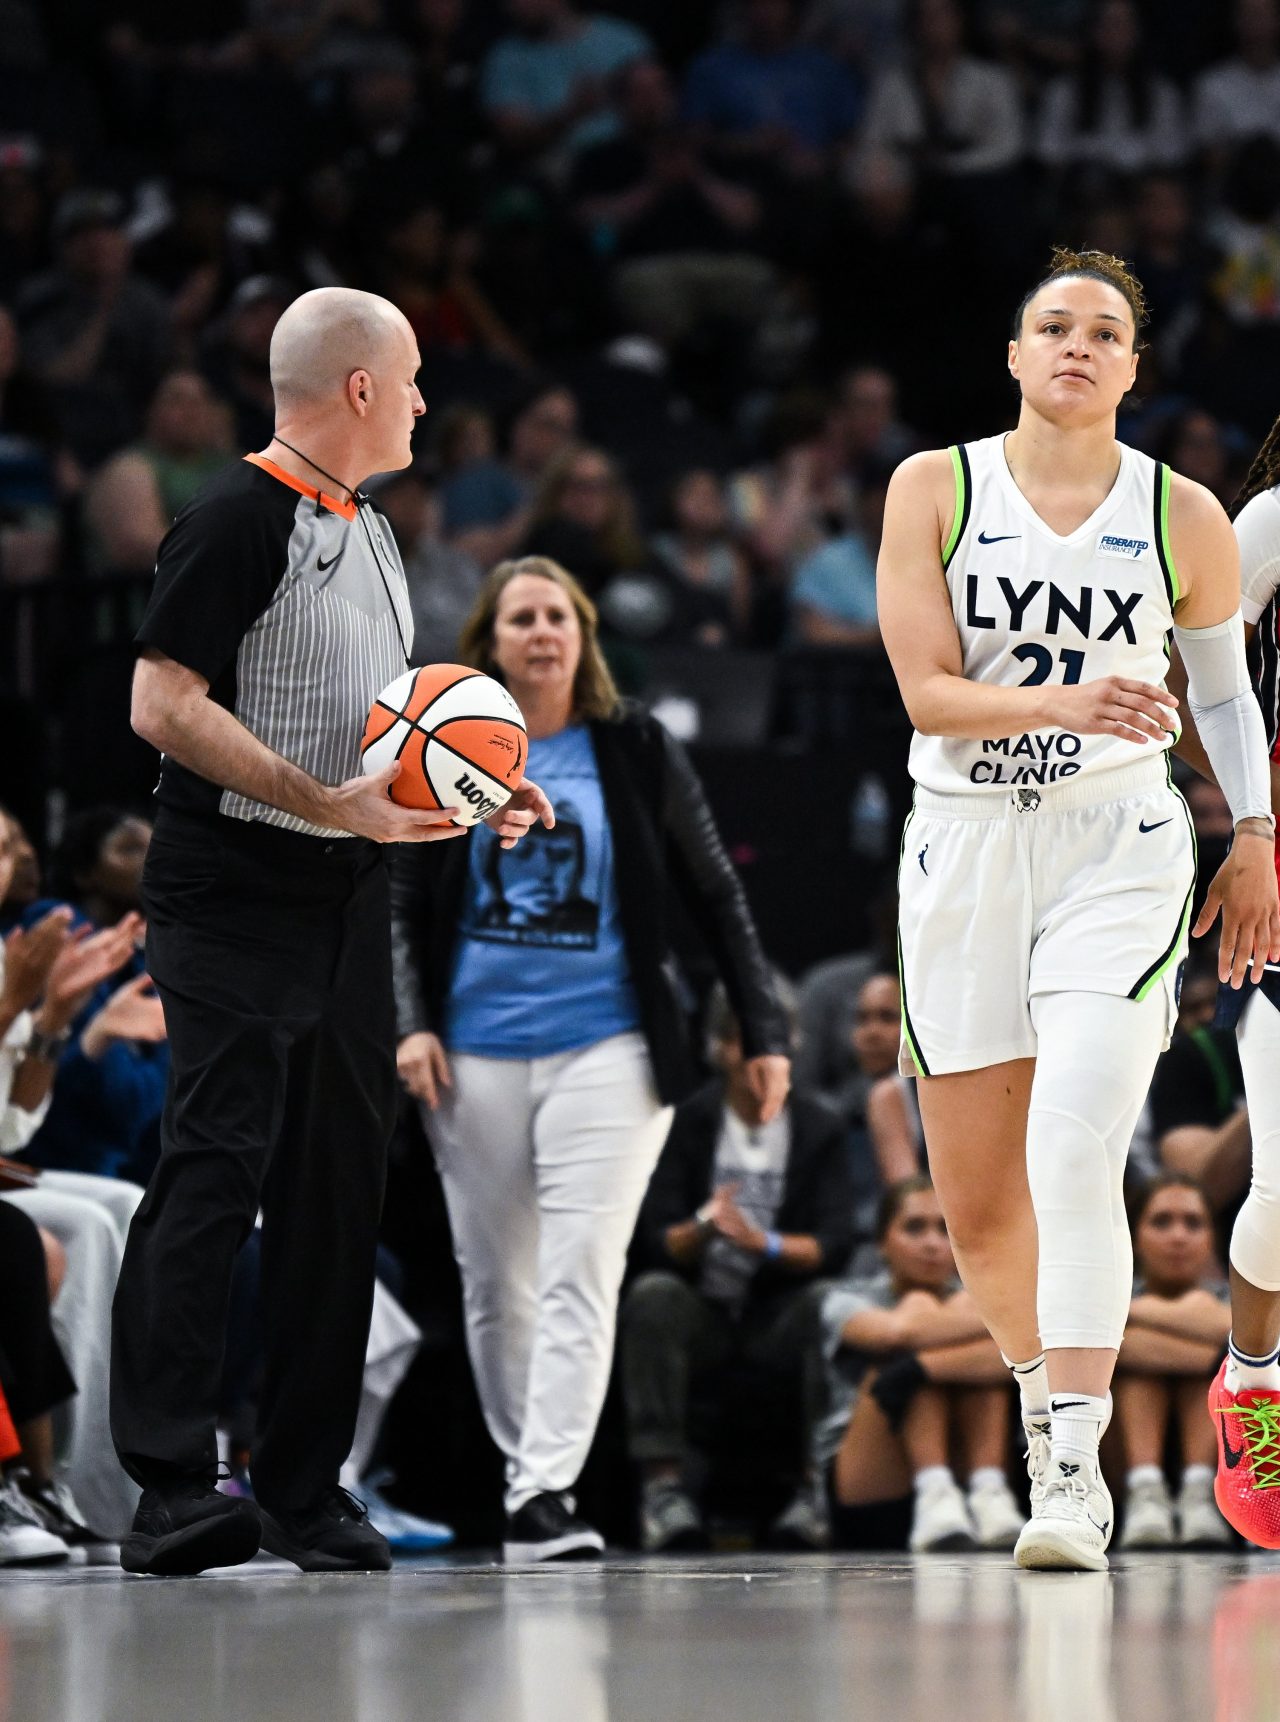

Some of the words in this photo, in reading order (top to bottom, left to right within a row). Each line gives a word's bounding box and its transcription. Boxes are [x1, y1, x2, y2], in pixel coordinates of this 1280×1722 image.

[1101, 535, 1149, 550] FEDERATED
[966, 574, 1144, 645] LYNX
[1011, 642, 1085, 687] 21
[982, 733, 1082, 760] MAYO
